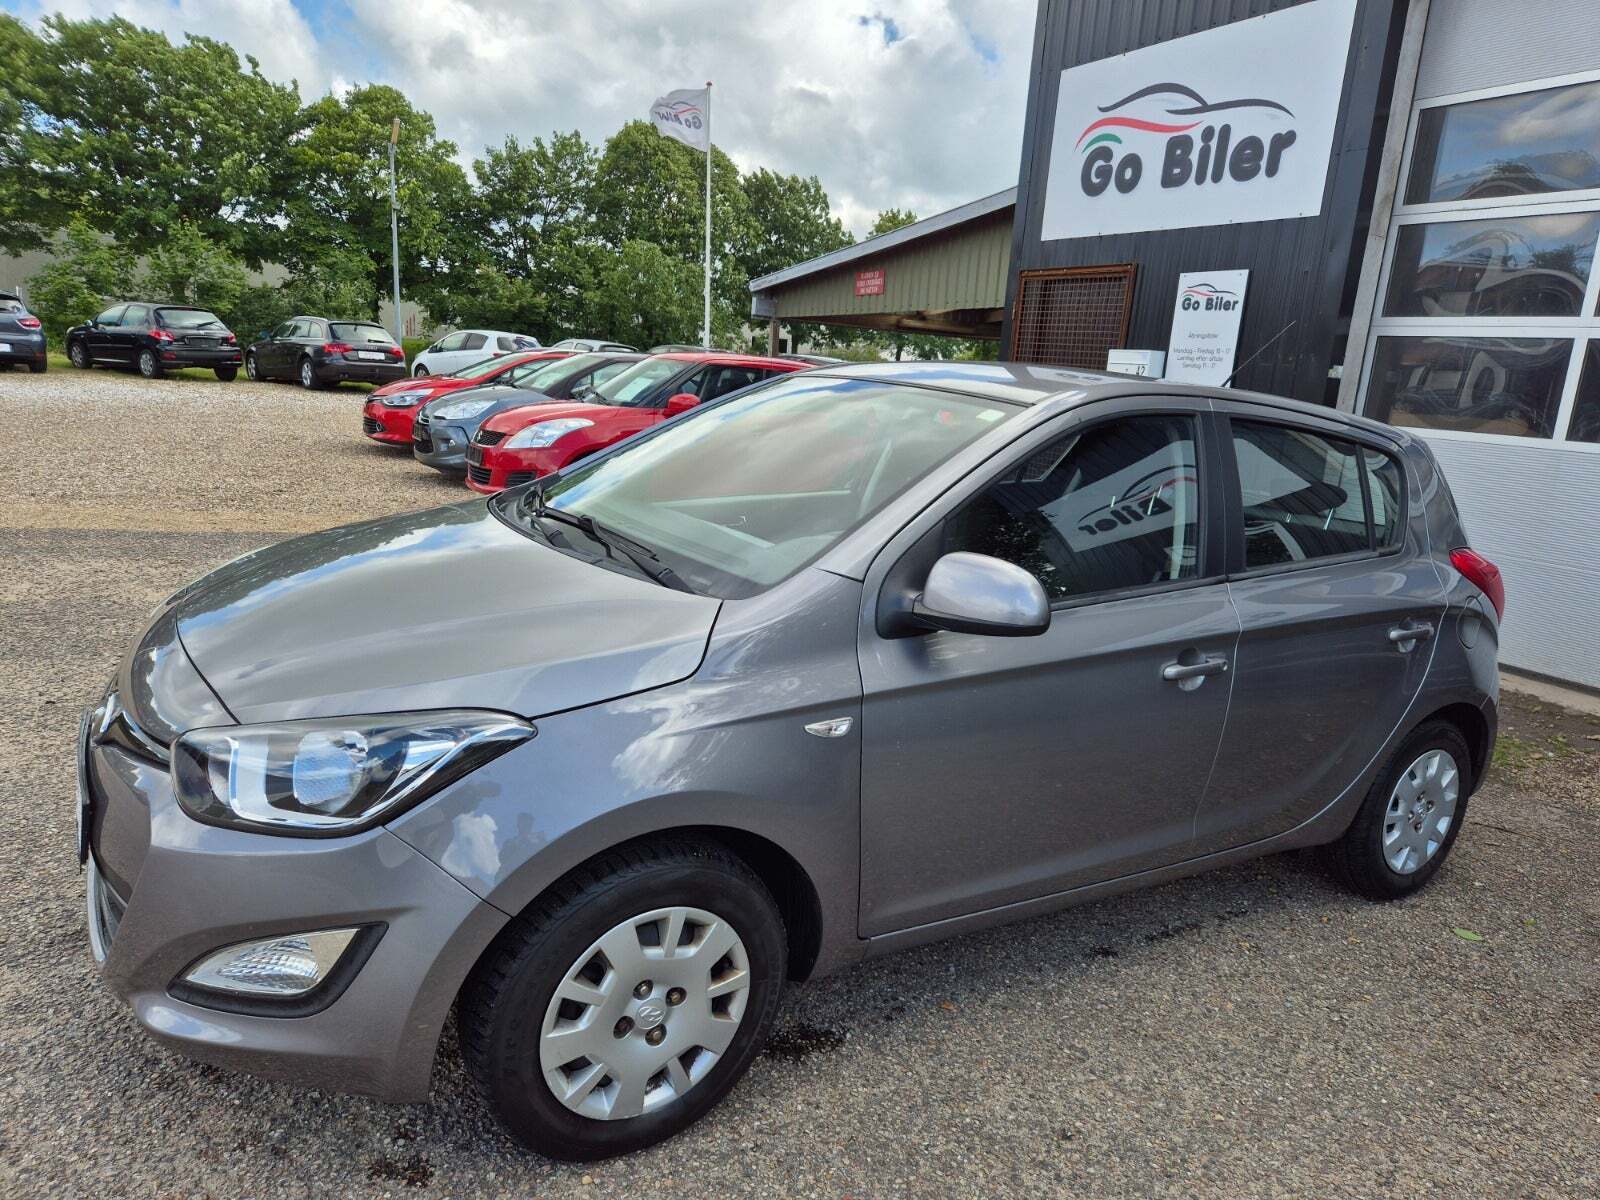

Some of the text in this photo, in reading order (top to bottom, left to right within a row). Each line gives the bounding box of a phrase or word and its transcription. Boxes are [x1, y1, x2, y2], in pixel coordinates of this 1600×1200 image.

[1081, 123, 1297, 197] Go Biler
[1182, 296, 1239, 311] Go Biler
